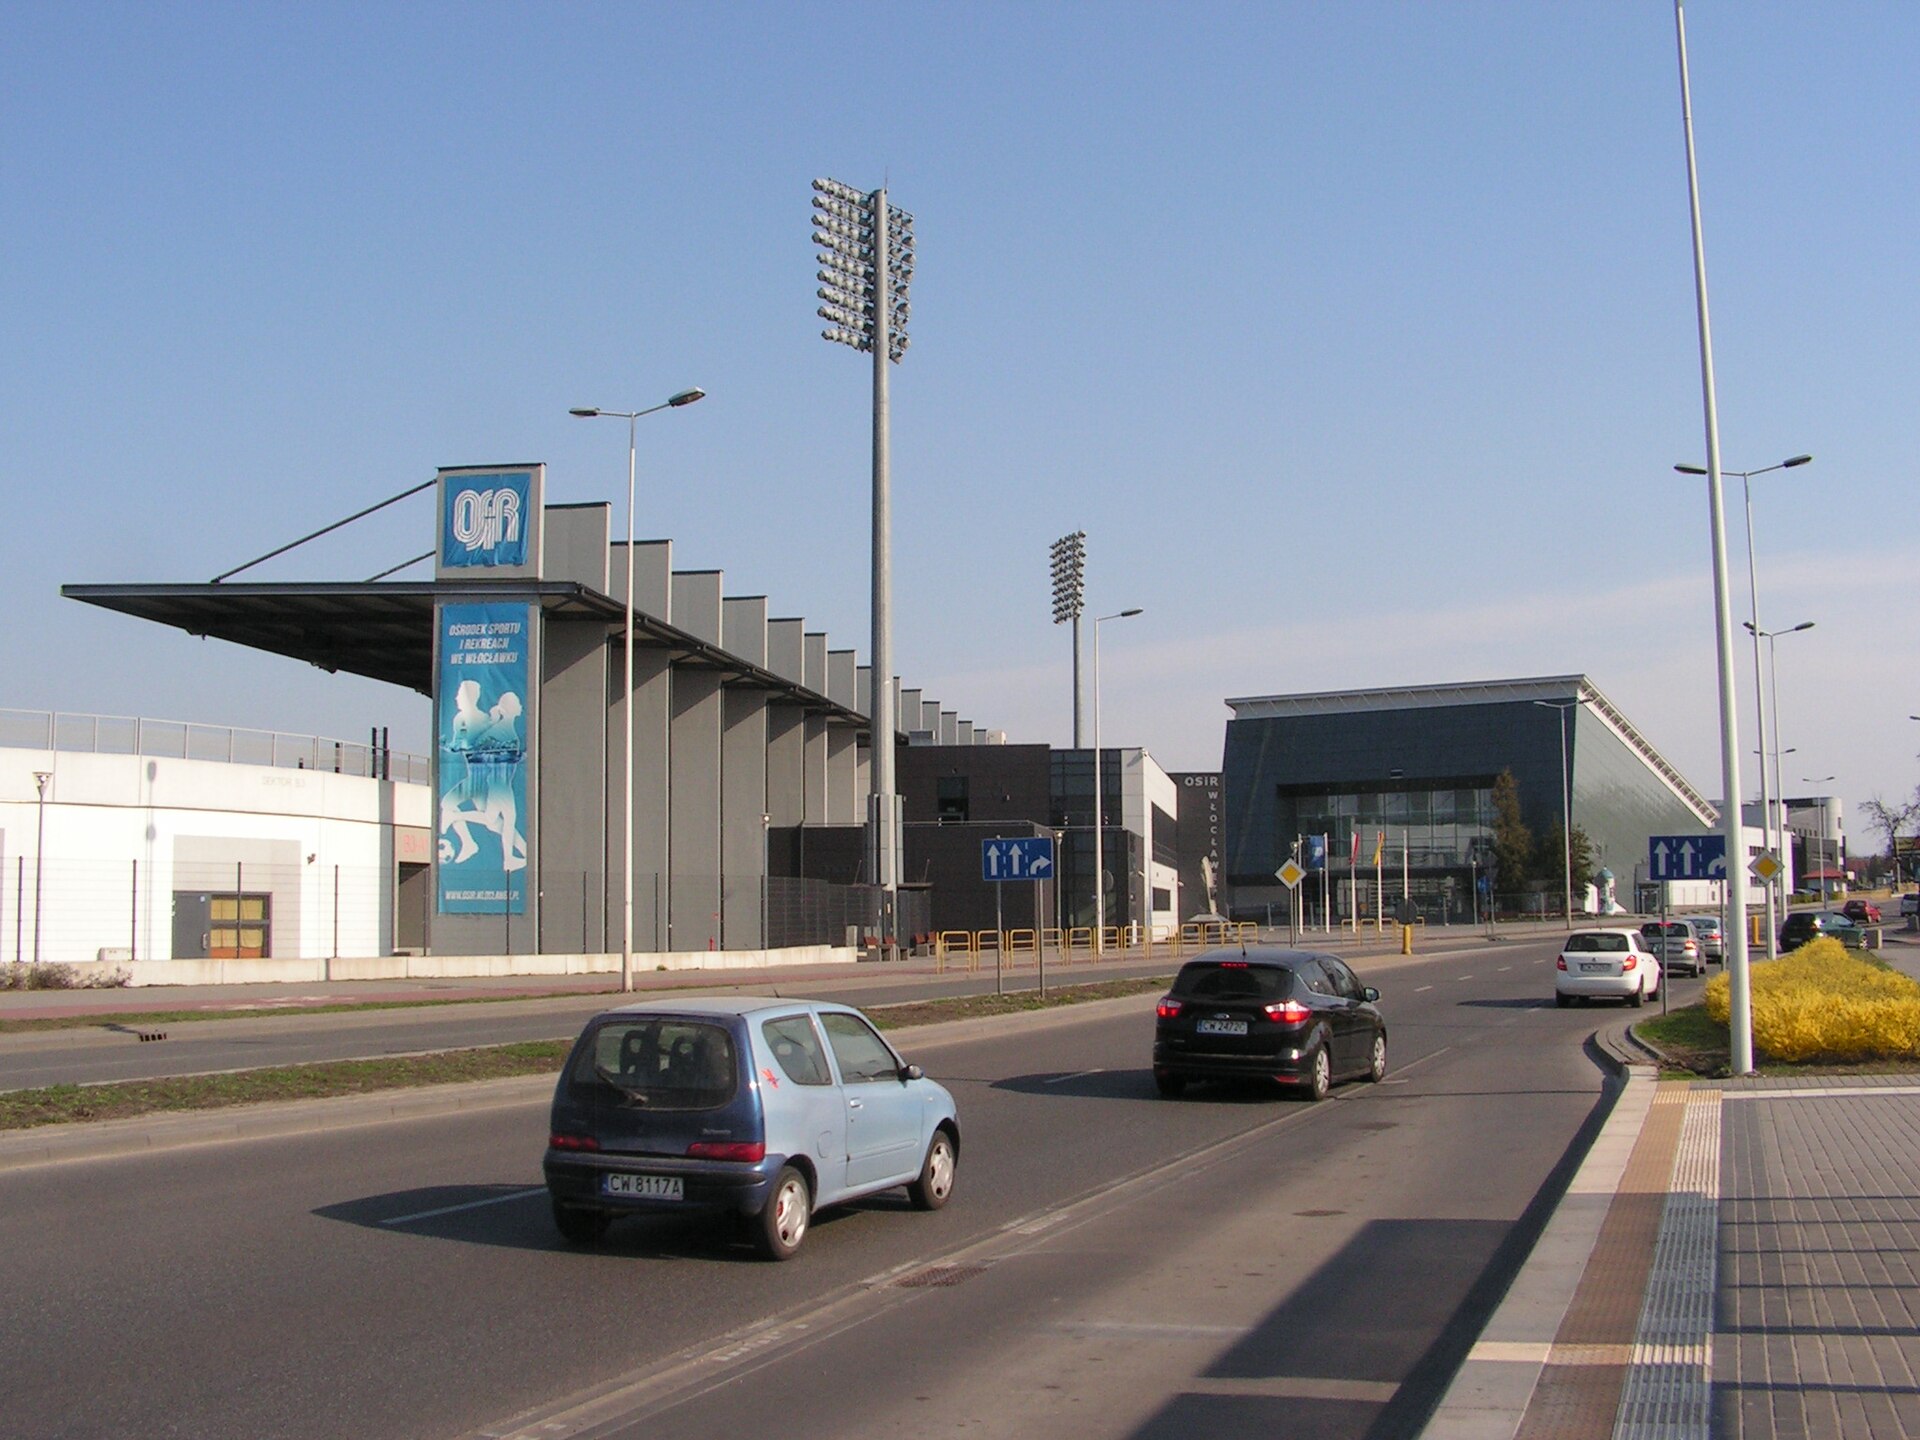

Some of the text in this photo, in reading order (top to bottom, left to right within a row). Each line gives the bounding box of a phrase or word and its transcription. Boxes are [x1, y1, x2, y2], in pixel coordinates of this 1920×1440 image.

[488, 622, 521, 635] SPORTU
[460, 638, 465, 650] I
[450, 652, 519, 665] WE WŁOCŁAWKU
[610, 1175, 681, 1195] CW 8117A
